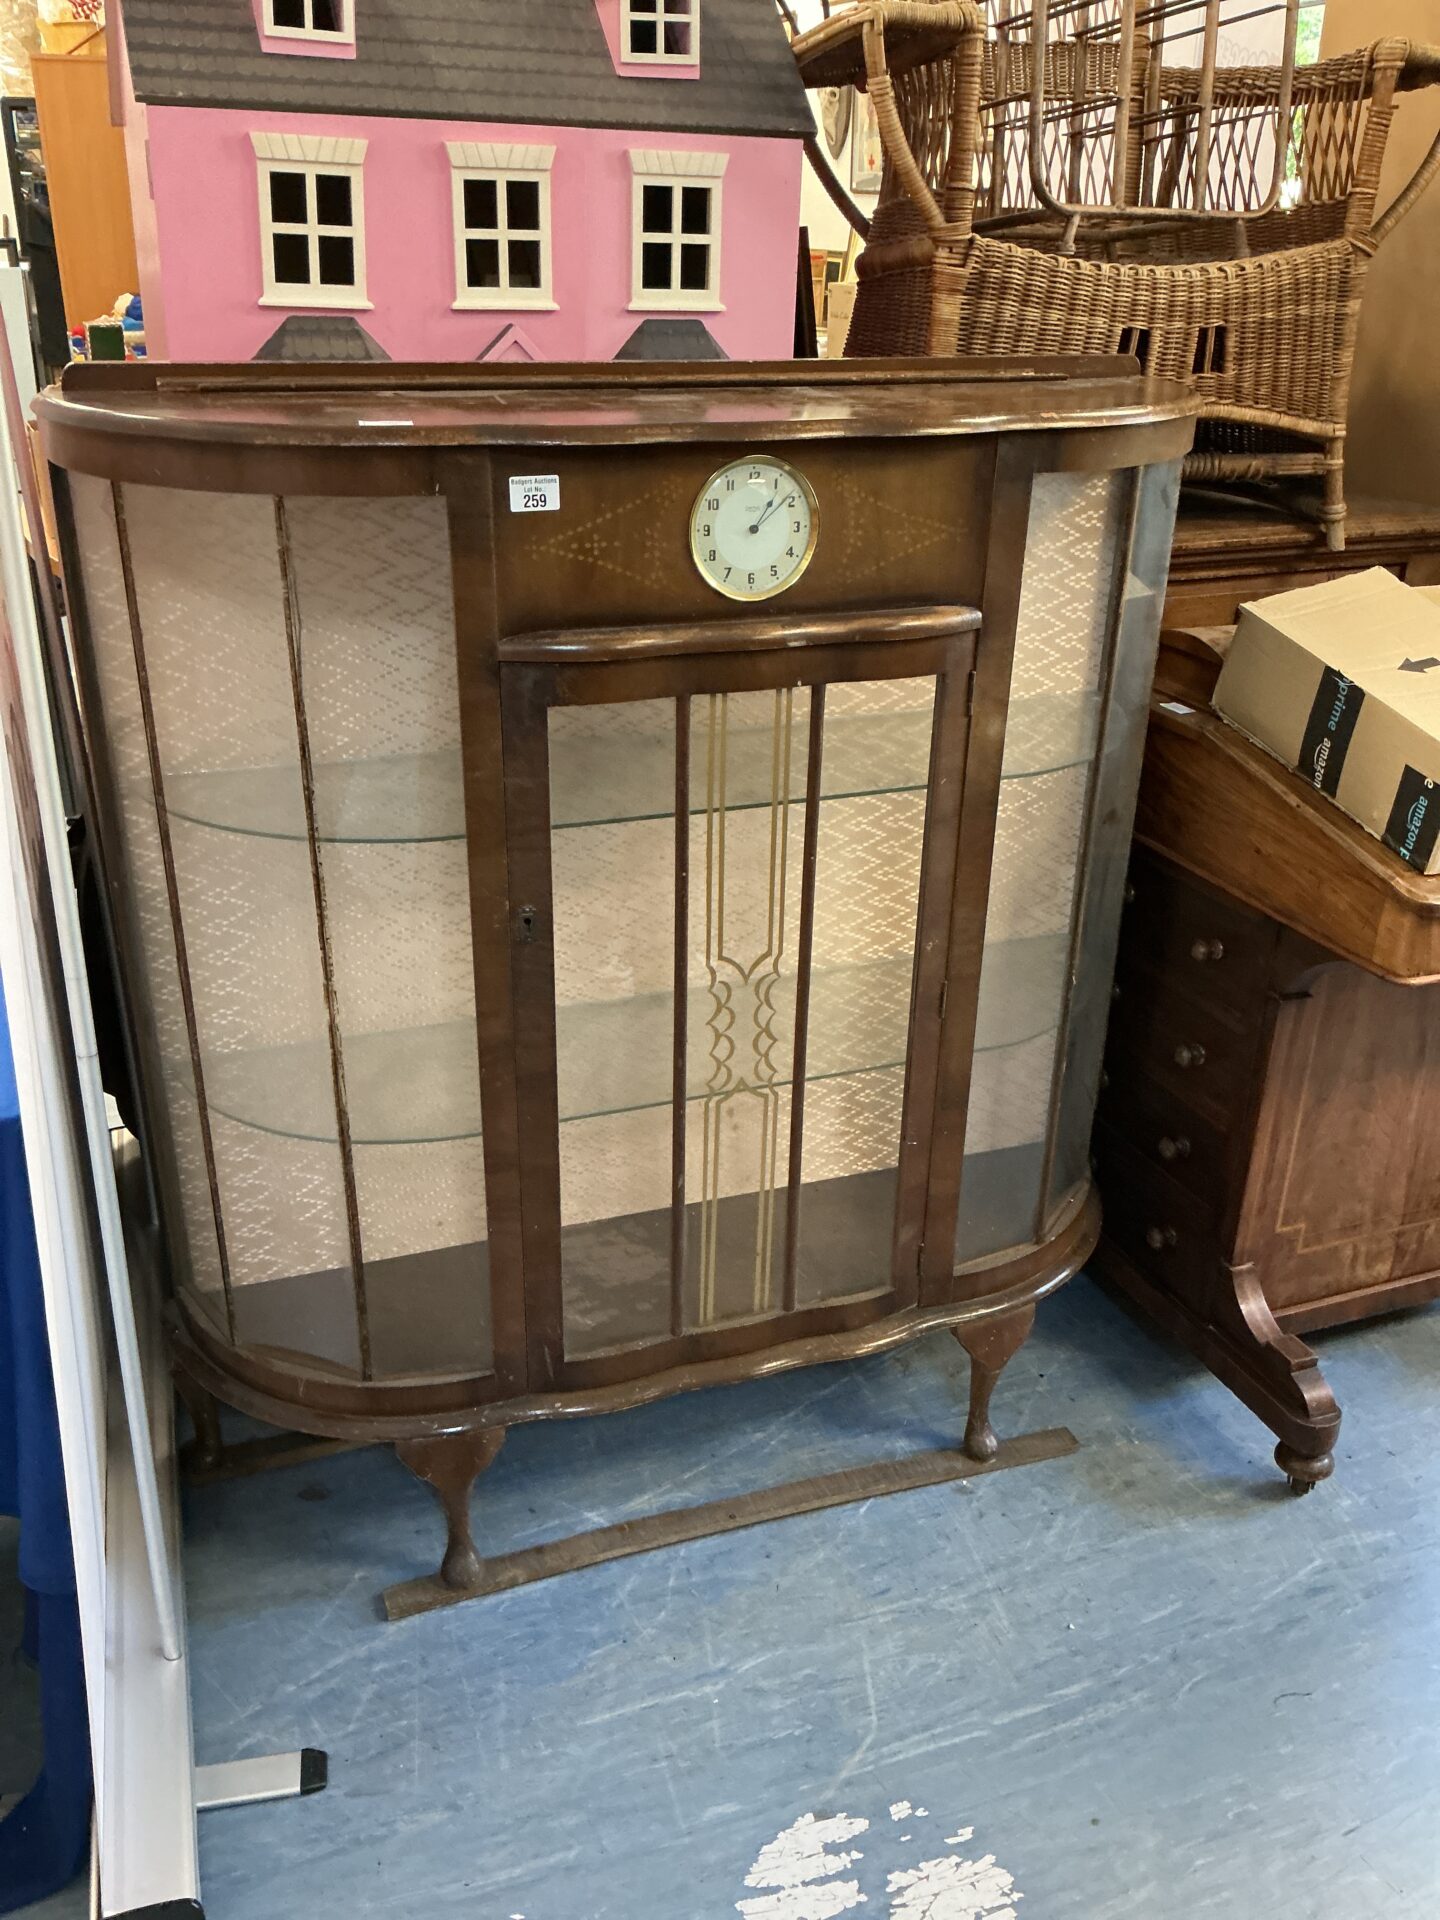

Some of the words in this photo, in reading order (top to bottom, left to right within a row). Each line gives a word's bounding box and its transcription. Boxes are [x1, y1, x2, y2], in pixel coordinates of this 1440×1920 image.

[726, 479, 735, 491] 11
[523, 493, 547, 508] 259
[707, 498, 720, 511] 10
[788, 496, 796, 508] 2
[703, 524, 711, 537] 9
[793, 521, 801, 533] 3
[708, 549, 716, 562] 8
[785, 546, 795, 558] 4
[723, 567, 732, 579] 7
[770, 565, 778, 577] 5
[747, 572, 755, 585] 6
[1327, 682, 1349, 731] prime
[1313, 737, 1331, 789] amazon
[1404, 795, 1429, 850] amazon
